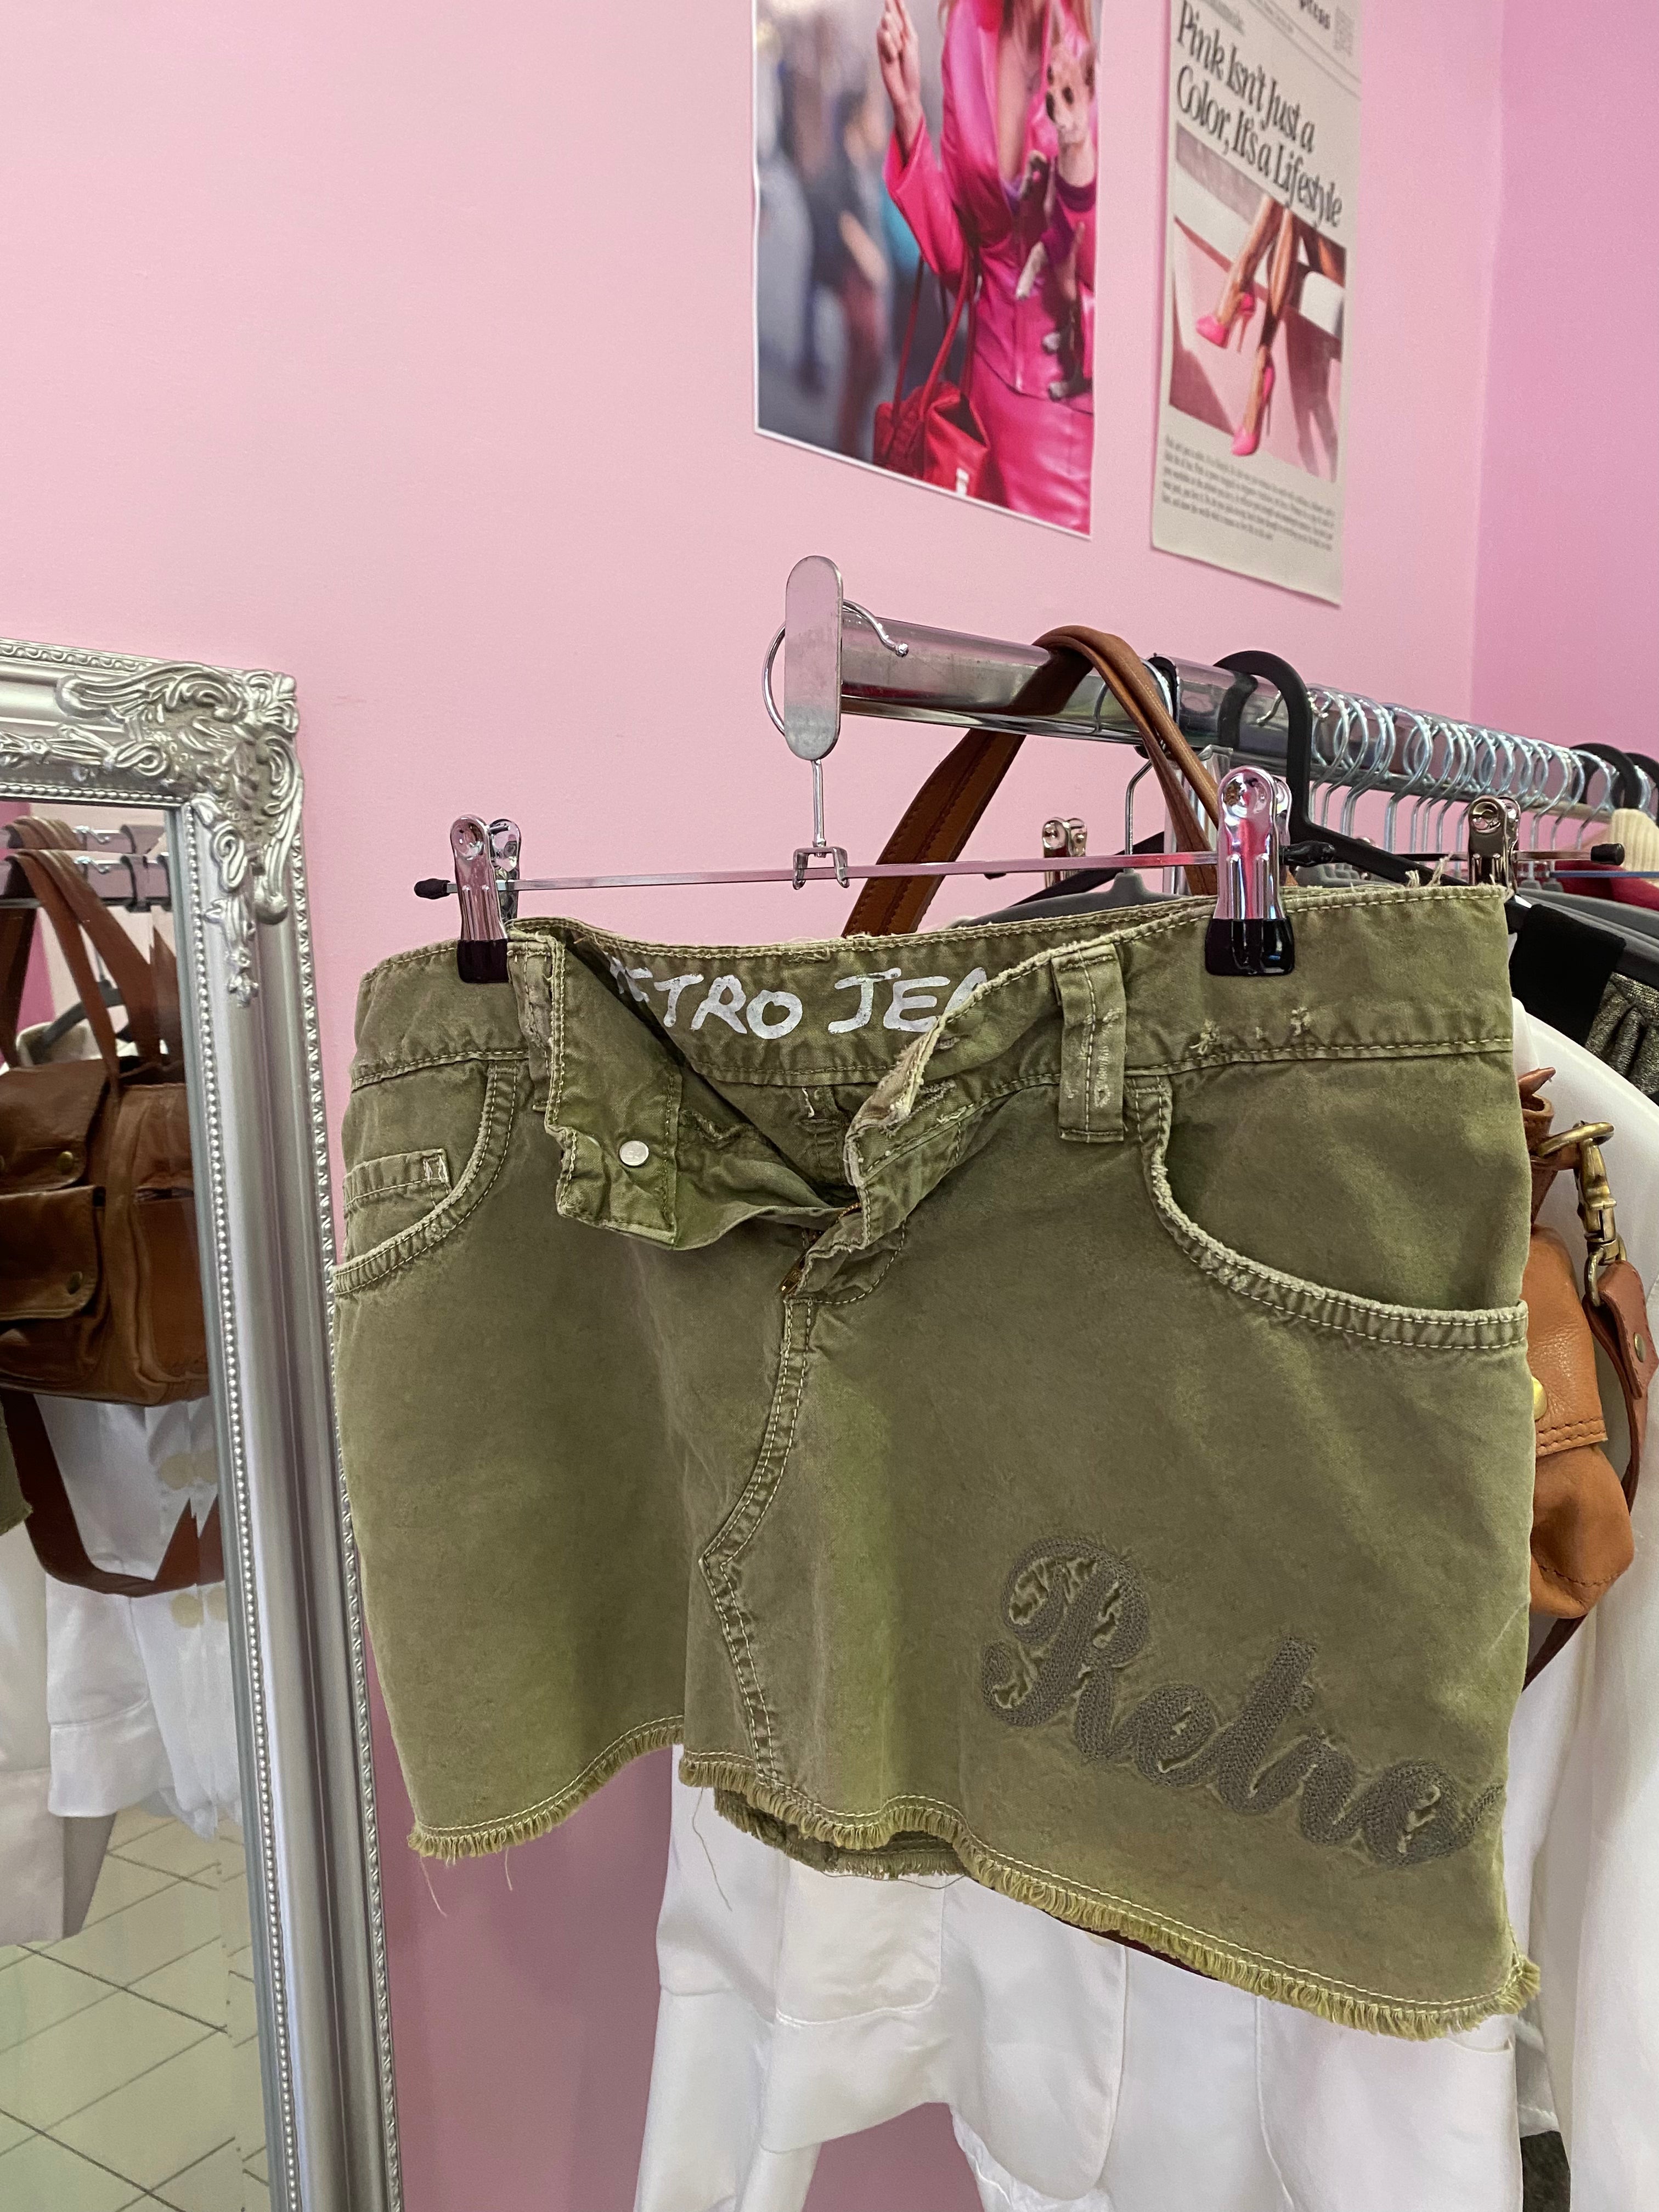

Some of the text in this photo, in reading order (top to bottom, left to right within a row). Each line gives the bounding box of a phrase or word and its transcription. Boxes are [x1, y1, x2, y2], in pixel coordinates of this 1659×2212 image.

[1177, 0, 1224, 81] Pink
[1261, 77, 1301, 142] Just
[1300, 120, 1315, 153] a
[1257, 143, 1272, 177] a
[1273, 143, 1342, 228] Lifestyle
